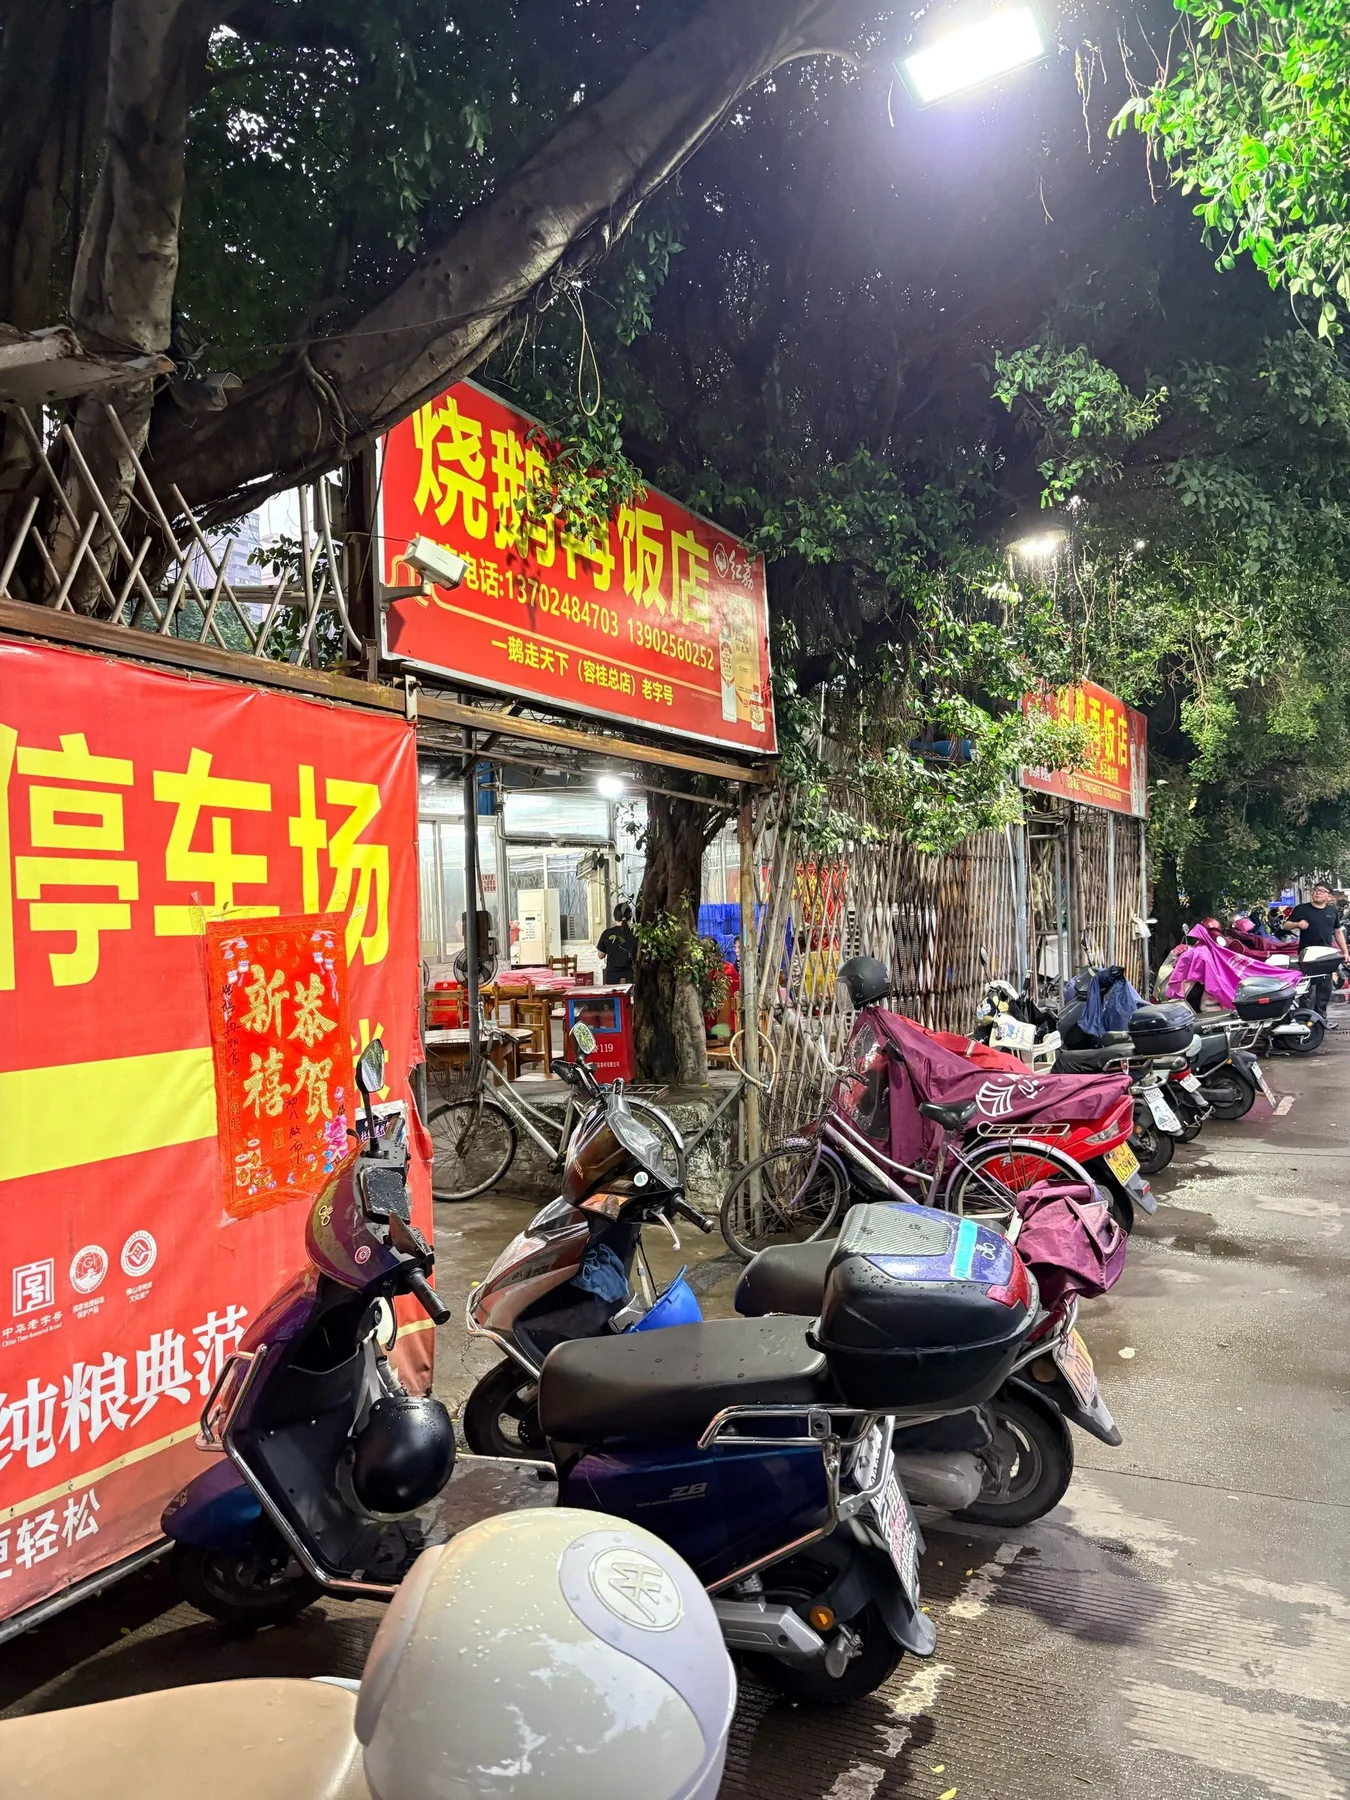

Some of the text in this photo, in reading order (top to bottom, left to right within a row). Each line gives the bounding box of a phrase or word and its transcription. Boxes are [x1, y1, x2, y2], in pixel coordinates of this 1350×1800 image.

[627, 618, 715, 672] 13902560252
[0, 723, 389, 990] 停车场
[2, 1311, 63, 1339] 中华老字号
[0, 1304, 248, 1471] 纯粮典范
